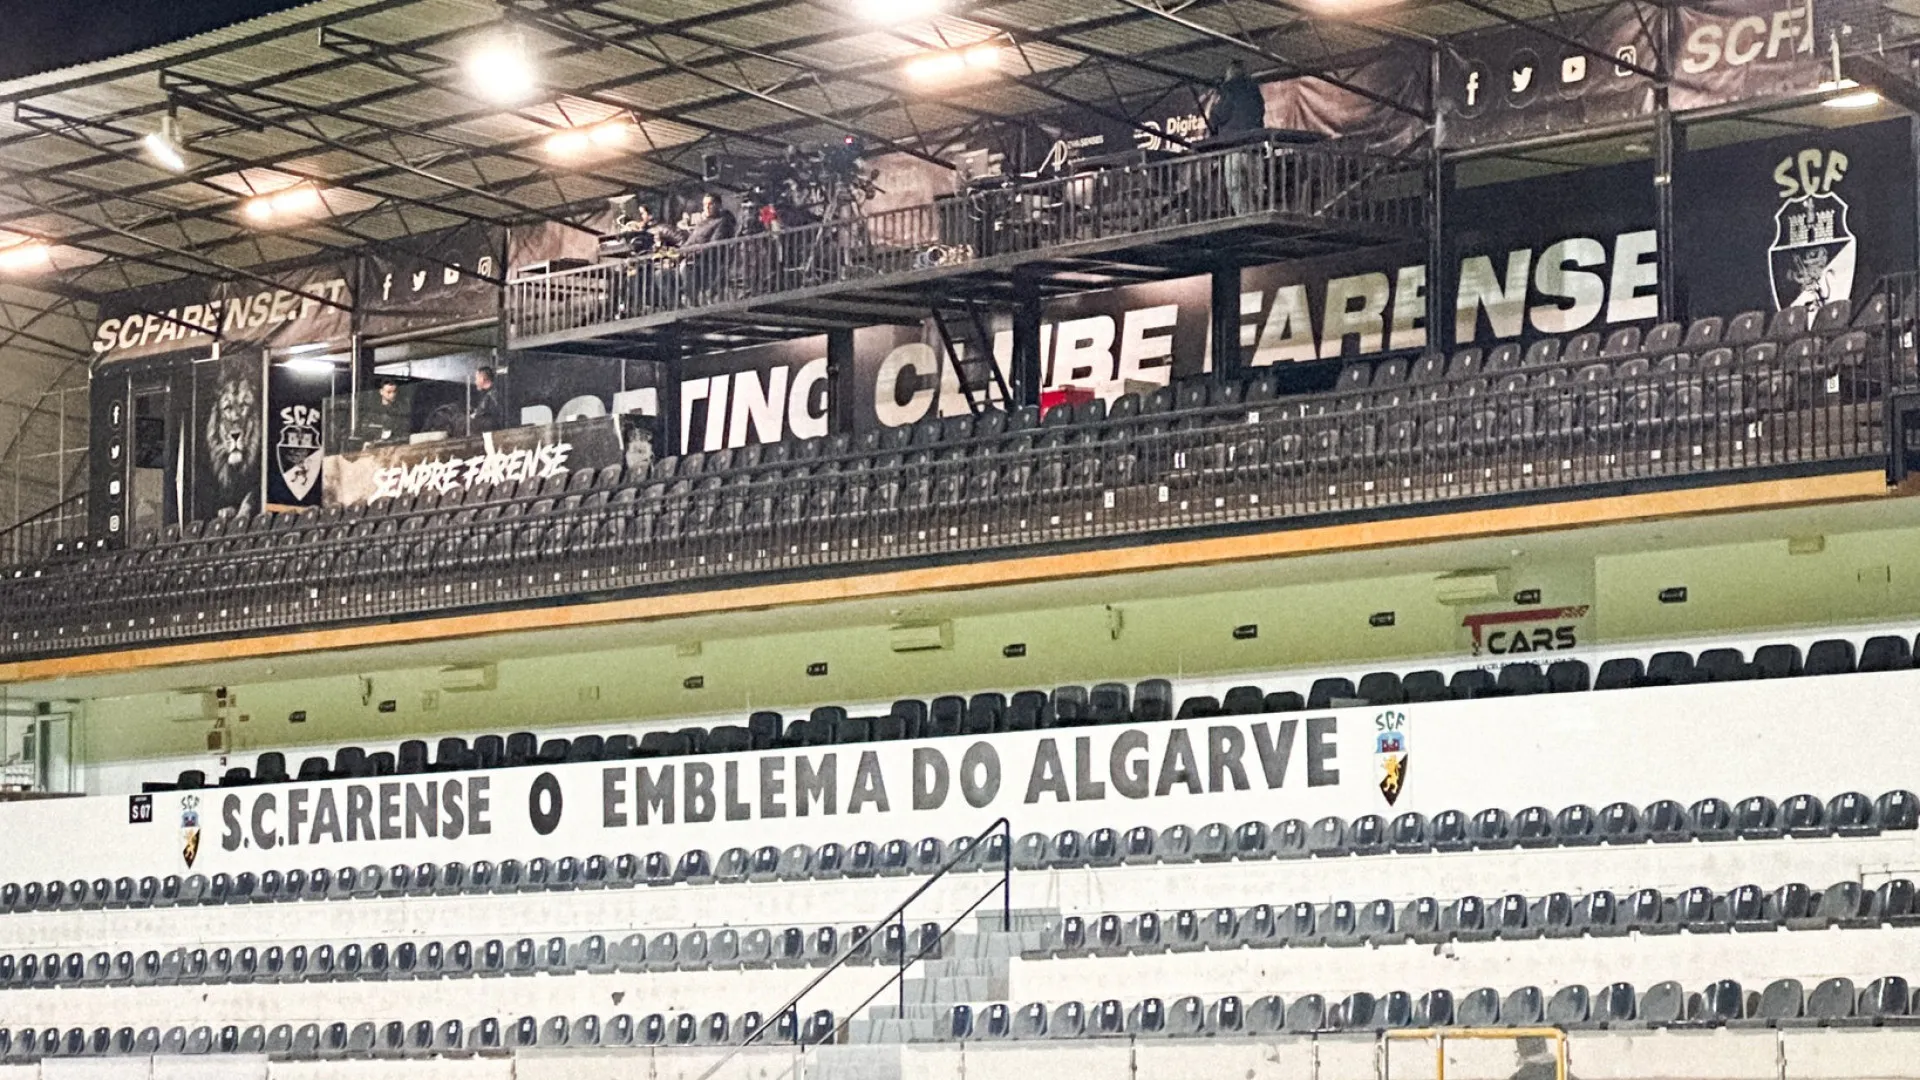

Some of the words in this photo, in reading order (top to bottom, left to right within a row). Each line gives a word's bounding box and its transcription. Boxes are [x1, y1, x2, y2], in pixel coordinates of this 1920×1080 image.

[1774, 149, 1848, 197] SCF
[280, 404, 320, 426] SCF
[367, 454, 464, 505] SEMPRE
[460, 432, 573, 490] FARENSE
[1375, 710, 1405, 731] SCF
[221, 776, 492, 852] S.C.FARENSE
[529, 772, 562, 836] O
[602, 750, 891, 828] EMBLEMA
[912, 741, 1002, 811] DO
[1023, 716, 1340, 805] ALGARVE
